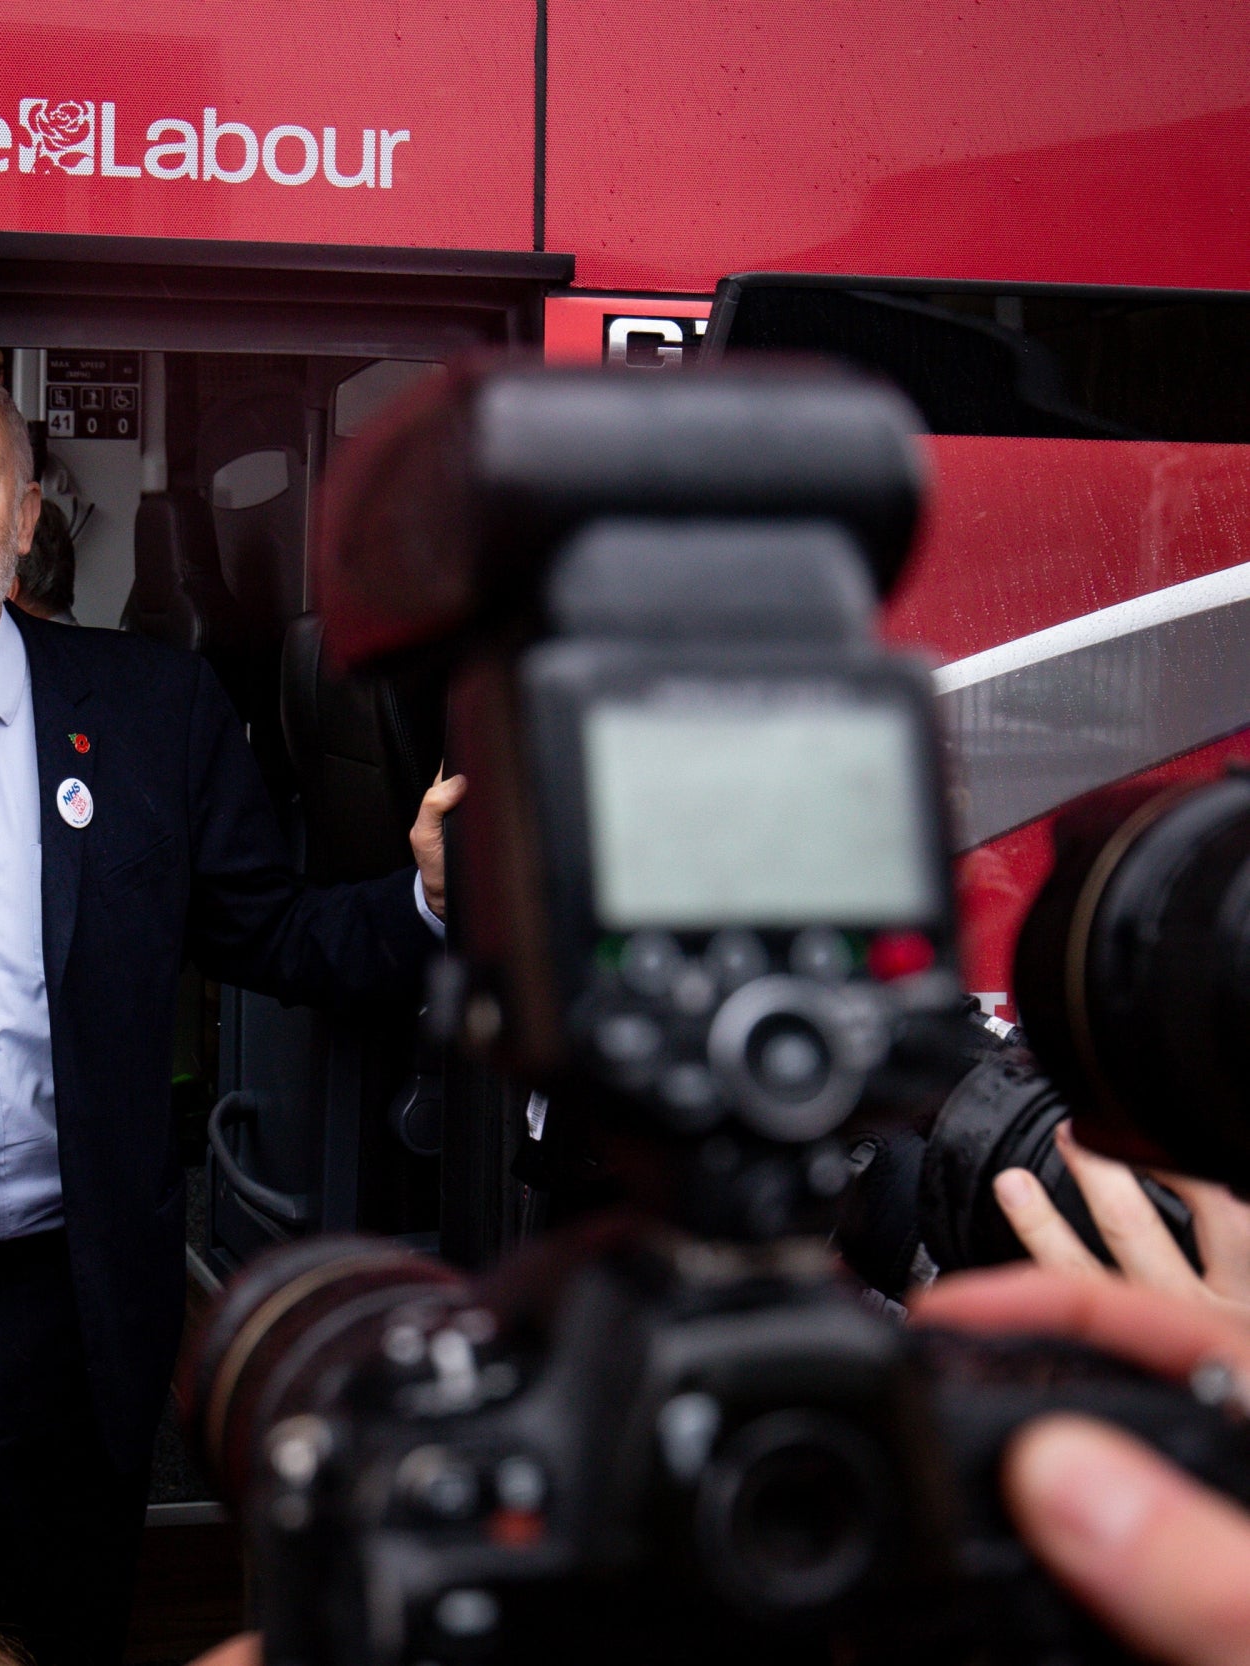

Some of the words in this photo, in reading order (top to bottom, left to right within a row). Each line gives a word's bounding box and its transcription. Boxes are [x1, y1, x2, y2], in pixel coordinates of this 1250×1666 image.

[100, 101, 410, 189] Labour
[50, 414, 70, 431] 41
[87, 417, 98, 434] 0
[118, 418, 129, 434] 0
[62, 782, 81, 805] NHS
